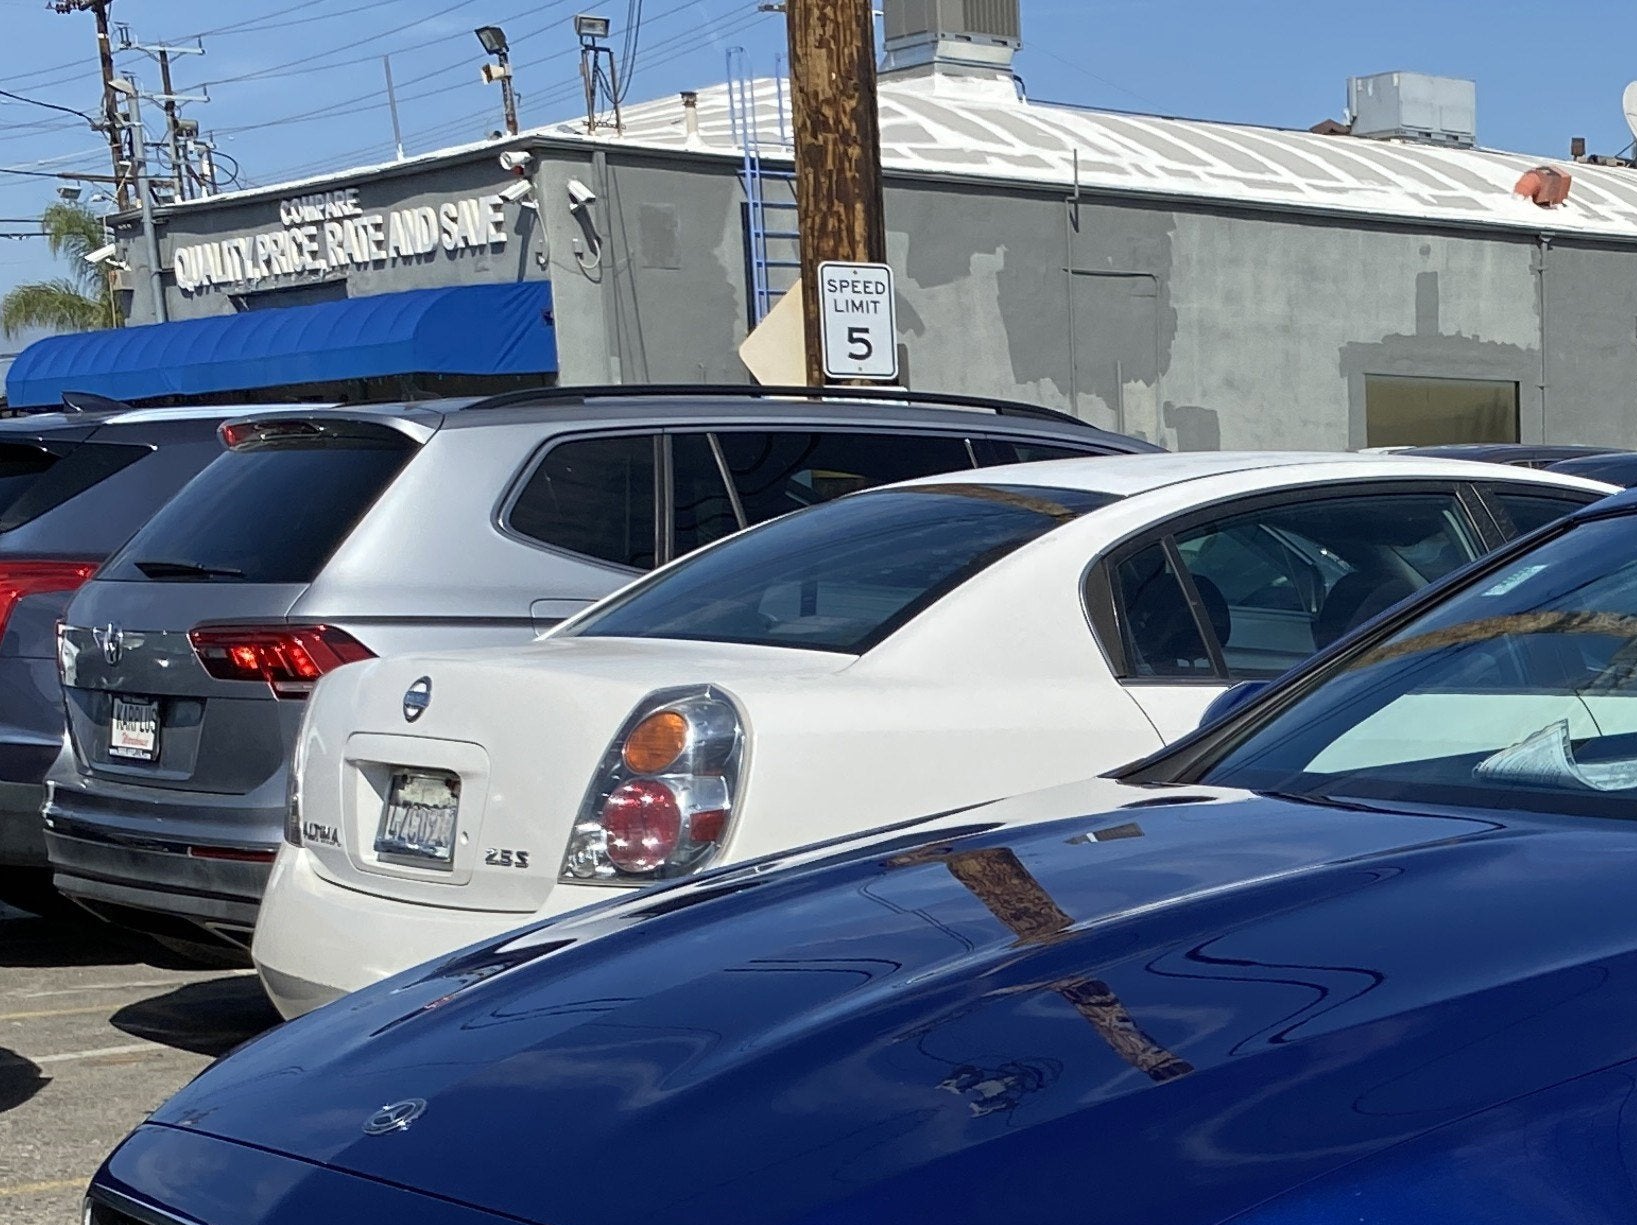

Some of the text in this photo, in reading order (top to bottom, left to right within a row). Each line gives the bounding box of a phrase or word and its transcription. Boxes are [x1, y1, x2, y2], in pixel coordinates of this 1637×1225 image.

[280, 189, 362, 225] COMPARE
[324, 214, 388, 266] RATE
[388, 206, 438, 258] AND
[440, 194, 508, 251] SAVE
[826, 278, 886, 295] SPEED
[833, 298, 881, 314] LIMIT
[847, 326, 873, 361] 5
